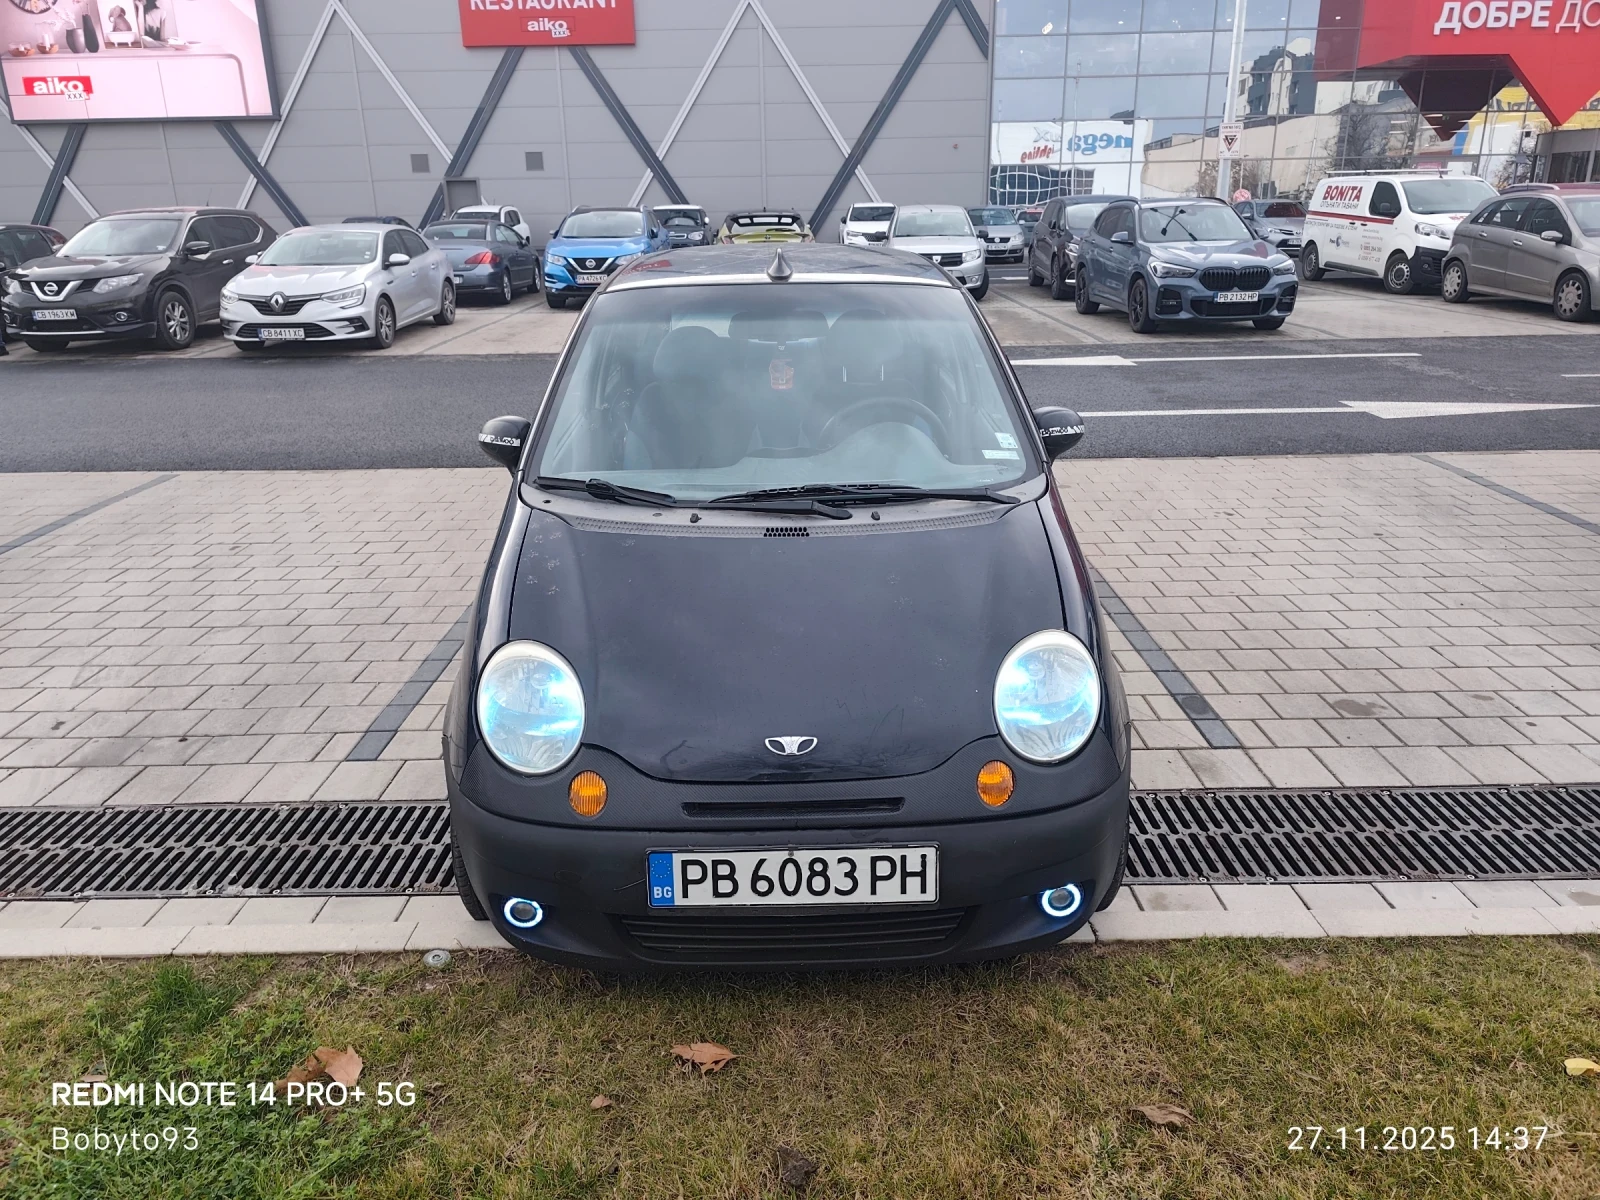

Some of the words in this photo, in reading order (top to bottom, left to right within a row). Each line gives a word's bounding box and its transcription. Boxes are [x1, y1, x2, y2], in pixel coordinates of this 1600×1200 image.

[527, 17, 568, 32] aiko
[1433, 0, 1552, 35] ДОБРЕ
[33, 77, 84, 94] aiko
[1323, 185, 1363, 202] BONITA
[1219, 293, 1228, 301] PB
[37, 311, 46, 319] CB
[262, 329, 273, 338] CB
[273, 329, 291, 337] 8411
[292, 329, 303, 337] XC
[680, 859, 739, 898] PB
[750, 857, 859, 897] 6083
[870, 853, 927, 895] PH
[653, 886, 672, 898] BG
